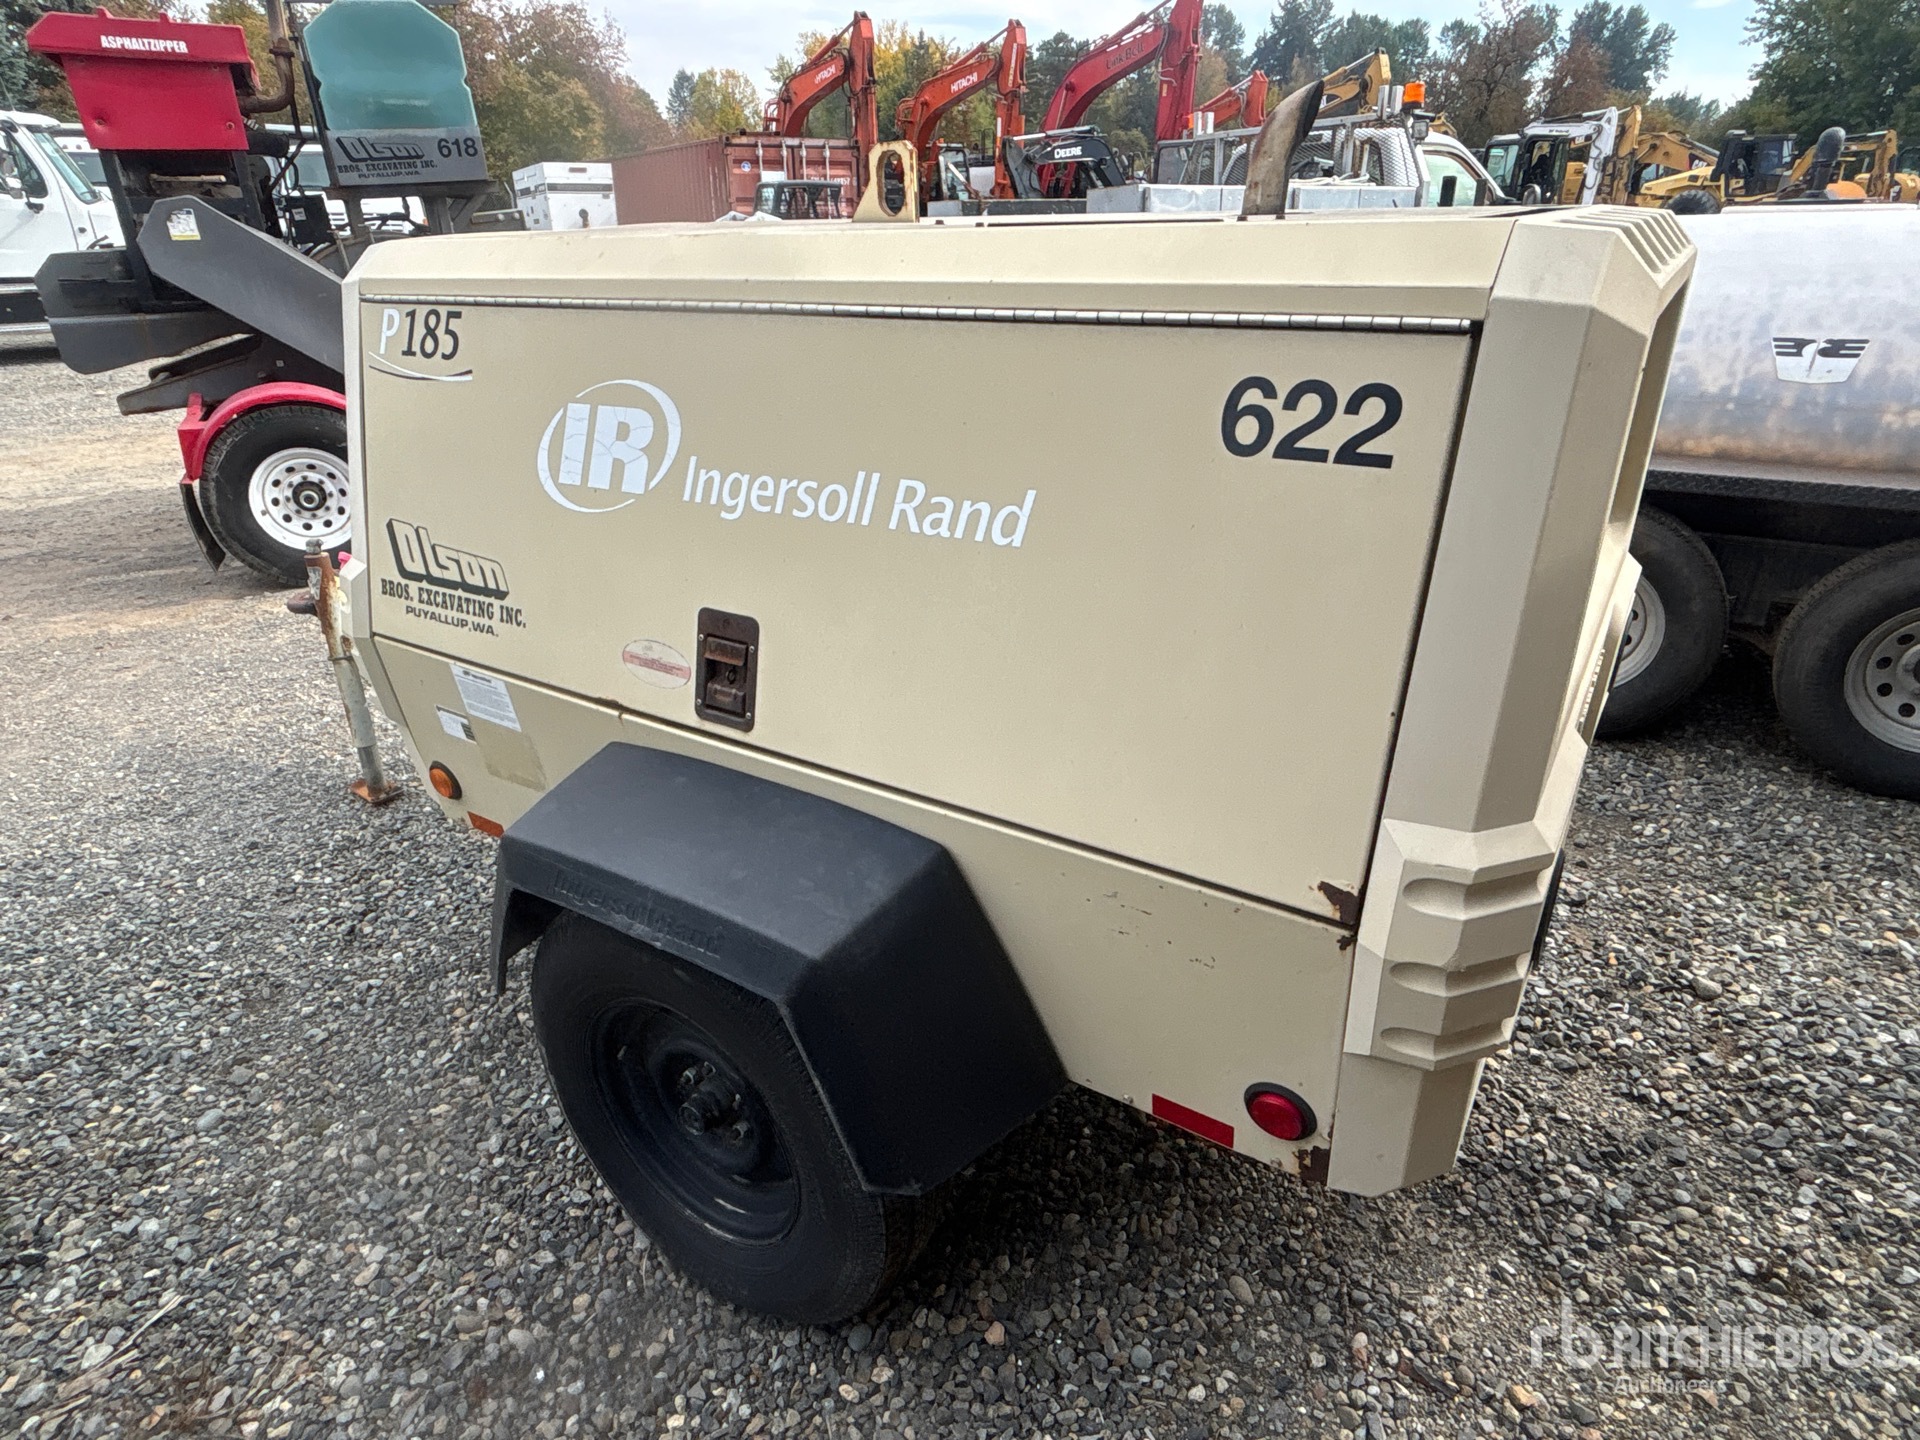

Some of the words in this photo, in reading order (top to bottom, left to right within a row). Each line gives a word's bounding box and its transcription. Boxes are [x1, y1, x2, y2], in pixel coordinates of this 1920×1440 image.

[100, 34, 189, 54] ASPHALTZIPPER
[951, 72, 978, 93] HITACHI
[437, 137, 478, 158] 618
[1054, 146, 1082, 159] DEERE
[337, 164, 363, 174] BROS.
[366, 161, 418, 172] EXCAVATING
[420, 160, 438, 169] INC.
[1221, 375, 1403, 469] 622
[558, 402, 654, 495] IR
[682, 455, 881, 526] Ingersoll
[888, 478, 1037, 548] Rand
[386, 517, 510, 601] Olson
[380, 578, 414, 602] BROS.
[417, 586, 495, 621] EXCAVATING
[499, 604, 527, 628] INC.
